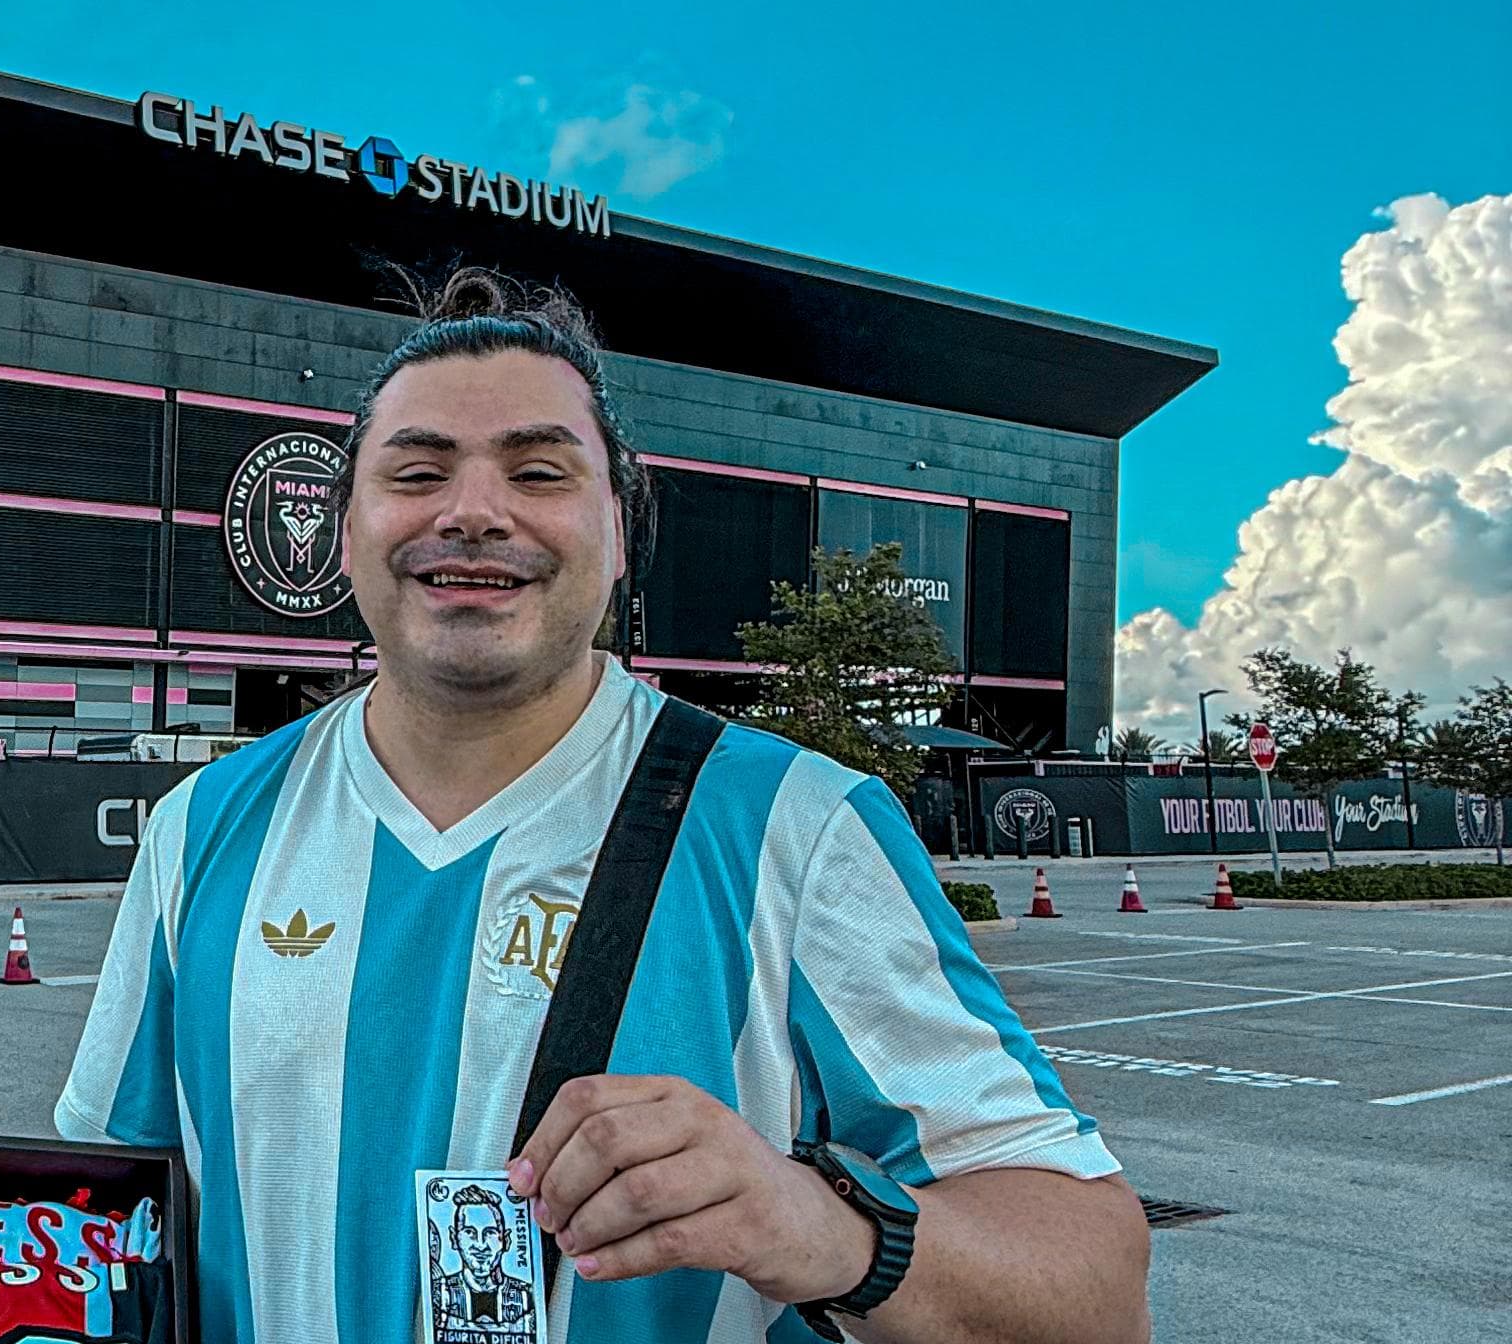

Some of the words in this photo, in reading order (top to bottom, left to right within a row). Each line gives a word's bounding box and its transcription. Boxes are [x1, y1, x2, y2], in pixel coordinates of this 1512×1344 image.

[140, 91, 350, 182] CHASE
[417, 153, 611, 237] STADIUM
[232, 518, 251, 568] CLUB
[276, 591, 323, 609] MMXX
[1251, 738, 1275, 755] STOP
[1160, 798, 1201, 834] YOUR
[1335, 794, 1366, 843] Your
